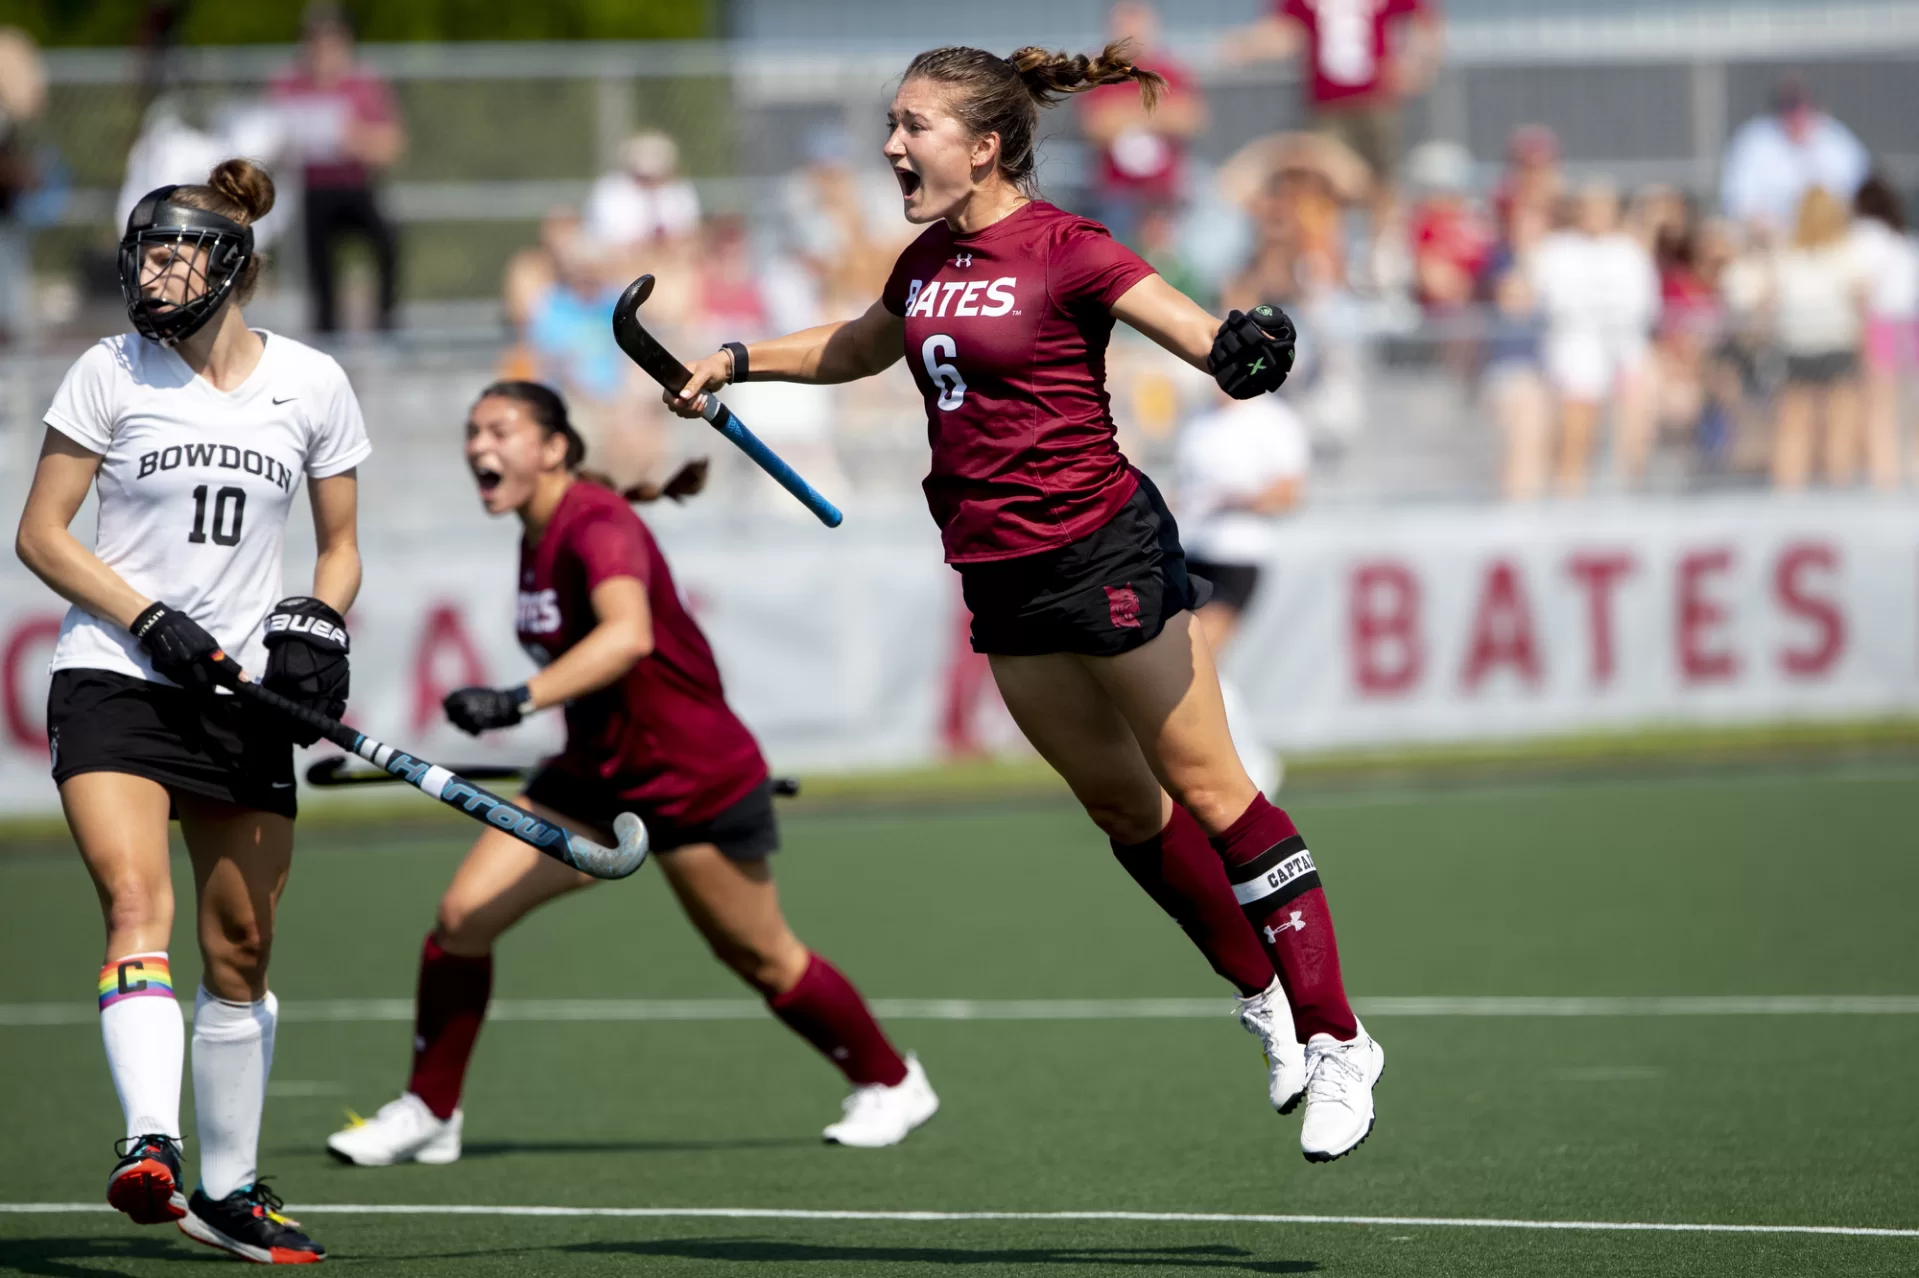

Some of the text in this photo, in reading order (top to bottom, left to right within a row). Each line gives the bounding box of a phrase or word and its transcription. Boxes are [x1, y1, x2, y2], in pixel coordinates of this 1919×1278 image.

[905, 276, 1017, 318] BATES
[922, 333, 967, 411] 6
[136, 443, 292, 494] BOWDOIN
[188, 485, 247, 547] 10
[264, 613, 348, 648] AUER
[1346, 537, 1849, 698] BATES
[387, 754, 561, 847] Hrrow
[118, 960, 147, 995] C
